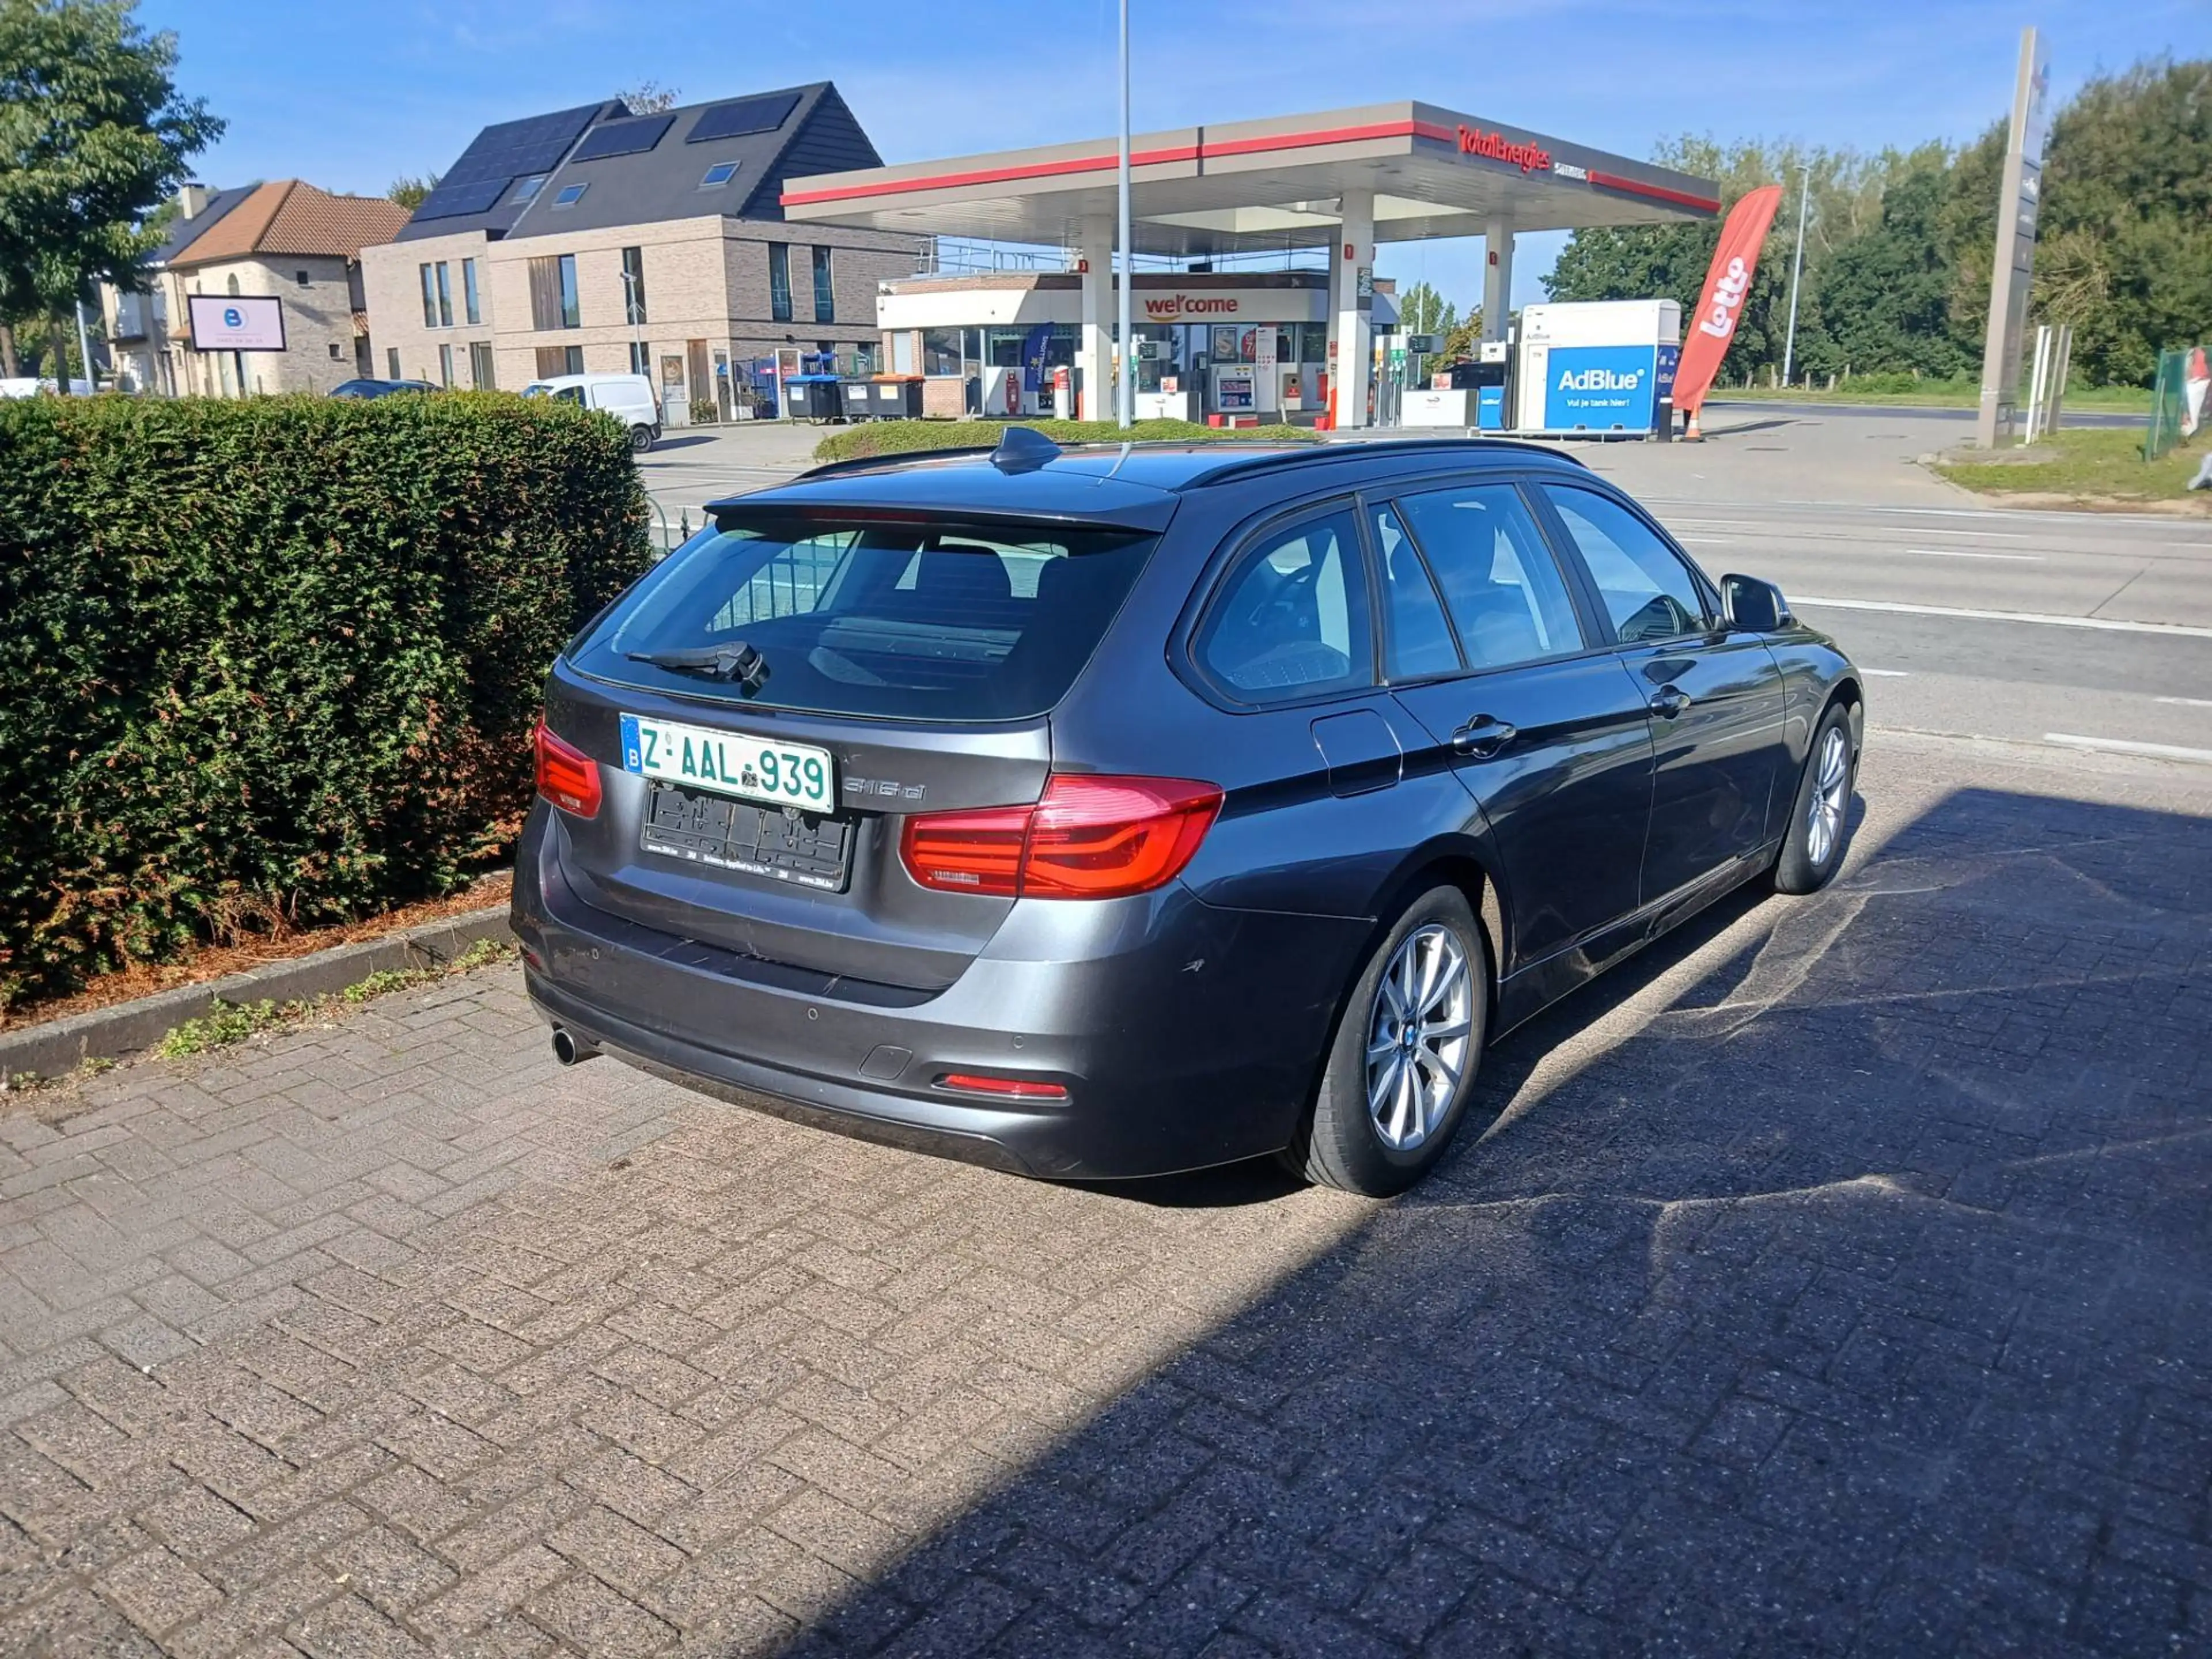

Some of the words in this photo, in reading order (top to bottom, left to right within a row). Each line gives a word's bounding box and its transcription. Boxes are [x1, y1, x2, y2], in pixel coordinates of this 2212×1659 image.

[1458, 124, 1550, 173] TotalEnergies
[1700, 256, 1749, 338] Lotto
[628, 748, 639, 767] B
[843, 777, 926, 800] 316d
